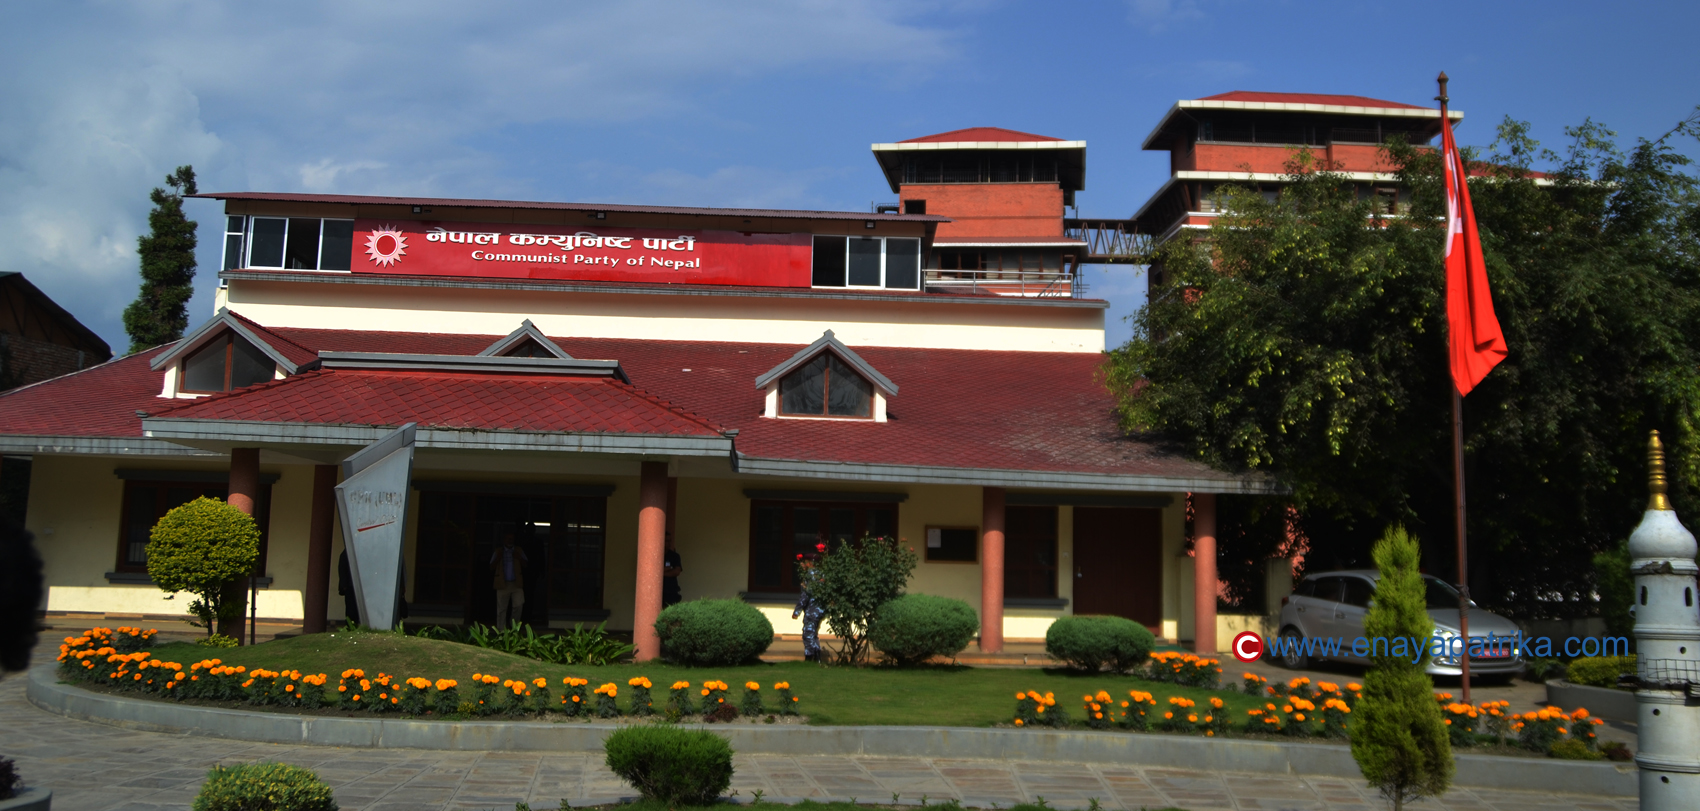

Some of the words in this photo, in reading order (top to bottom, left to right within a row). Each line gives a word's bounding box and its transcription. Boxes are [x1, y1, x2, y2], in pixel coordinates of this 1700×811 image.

[426, 227, 501, 245] नेपाल
[509, 231, 633, 251] कम्युनिष्ट
[642, 236, 696, 251] पार्टी
[471, 250, 568, 264] Communist
[574, 254, 619, 267] Party
[627, 255, 644, 266] of
[651, 257, 700, 270] Nepal
